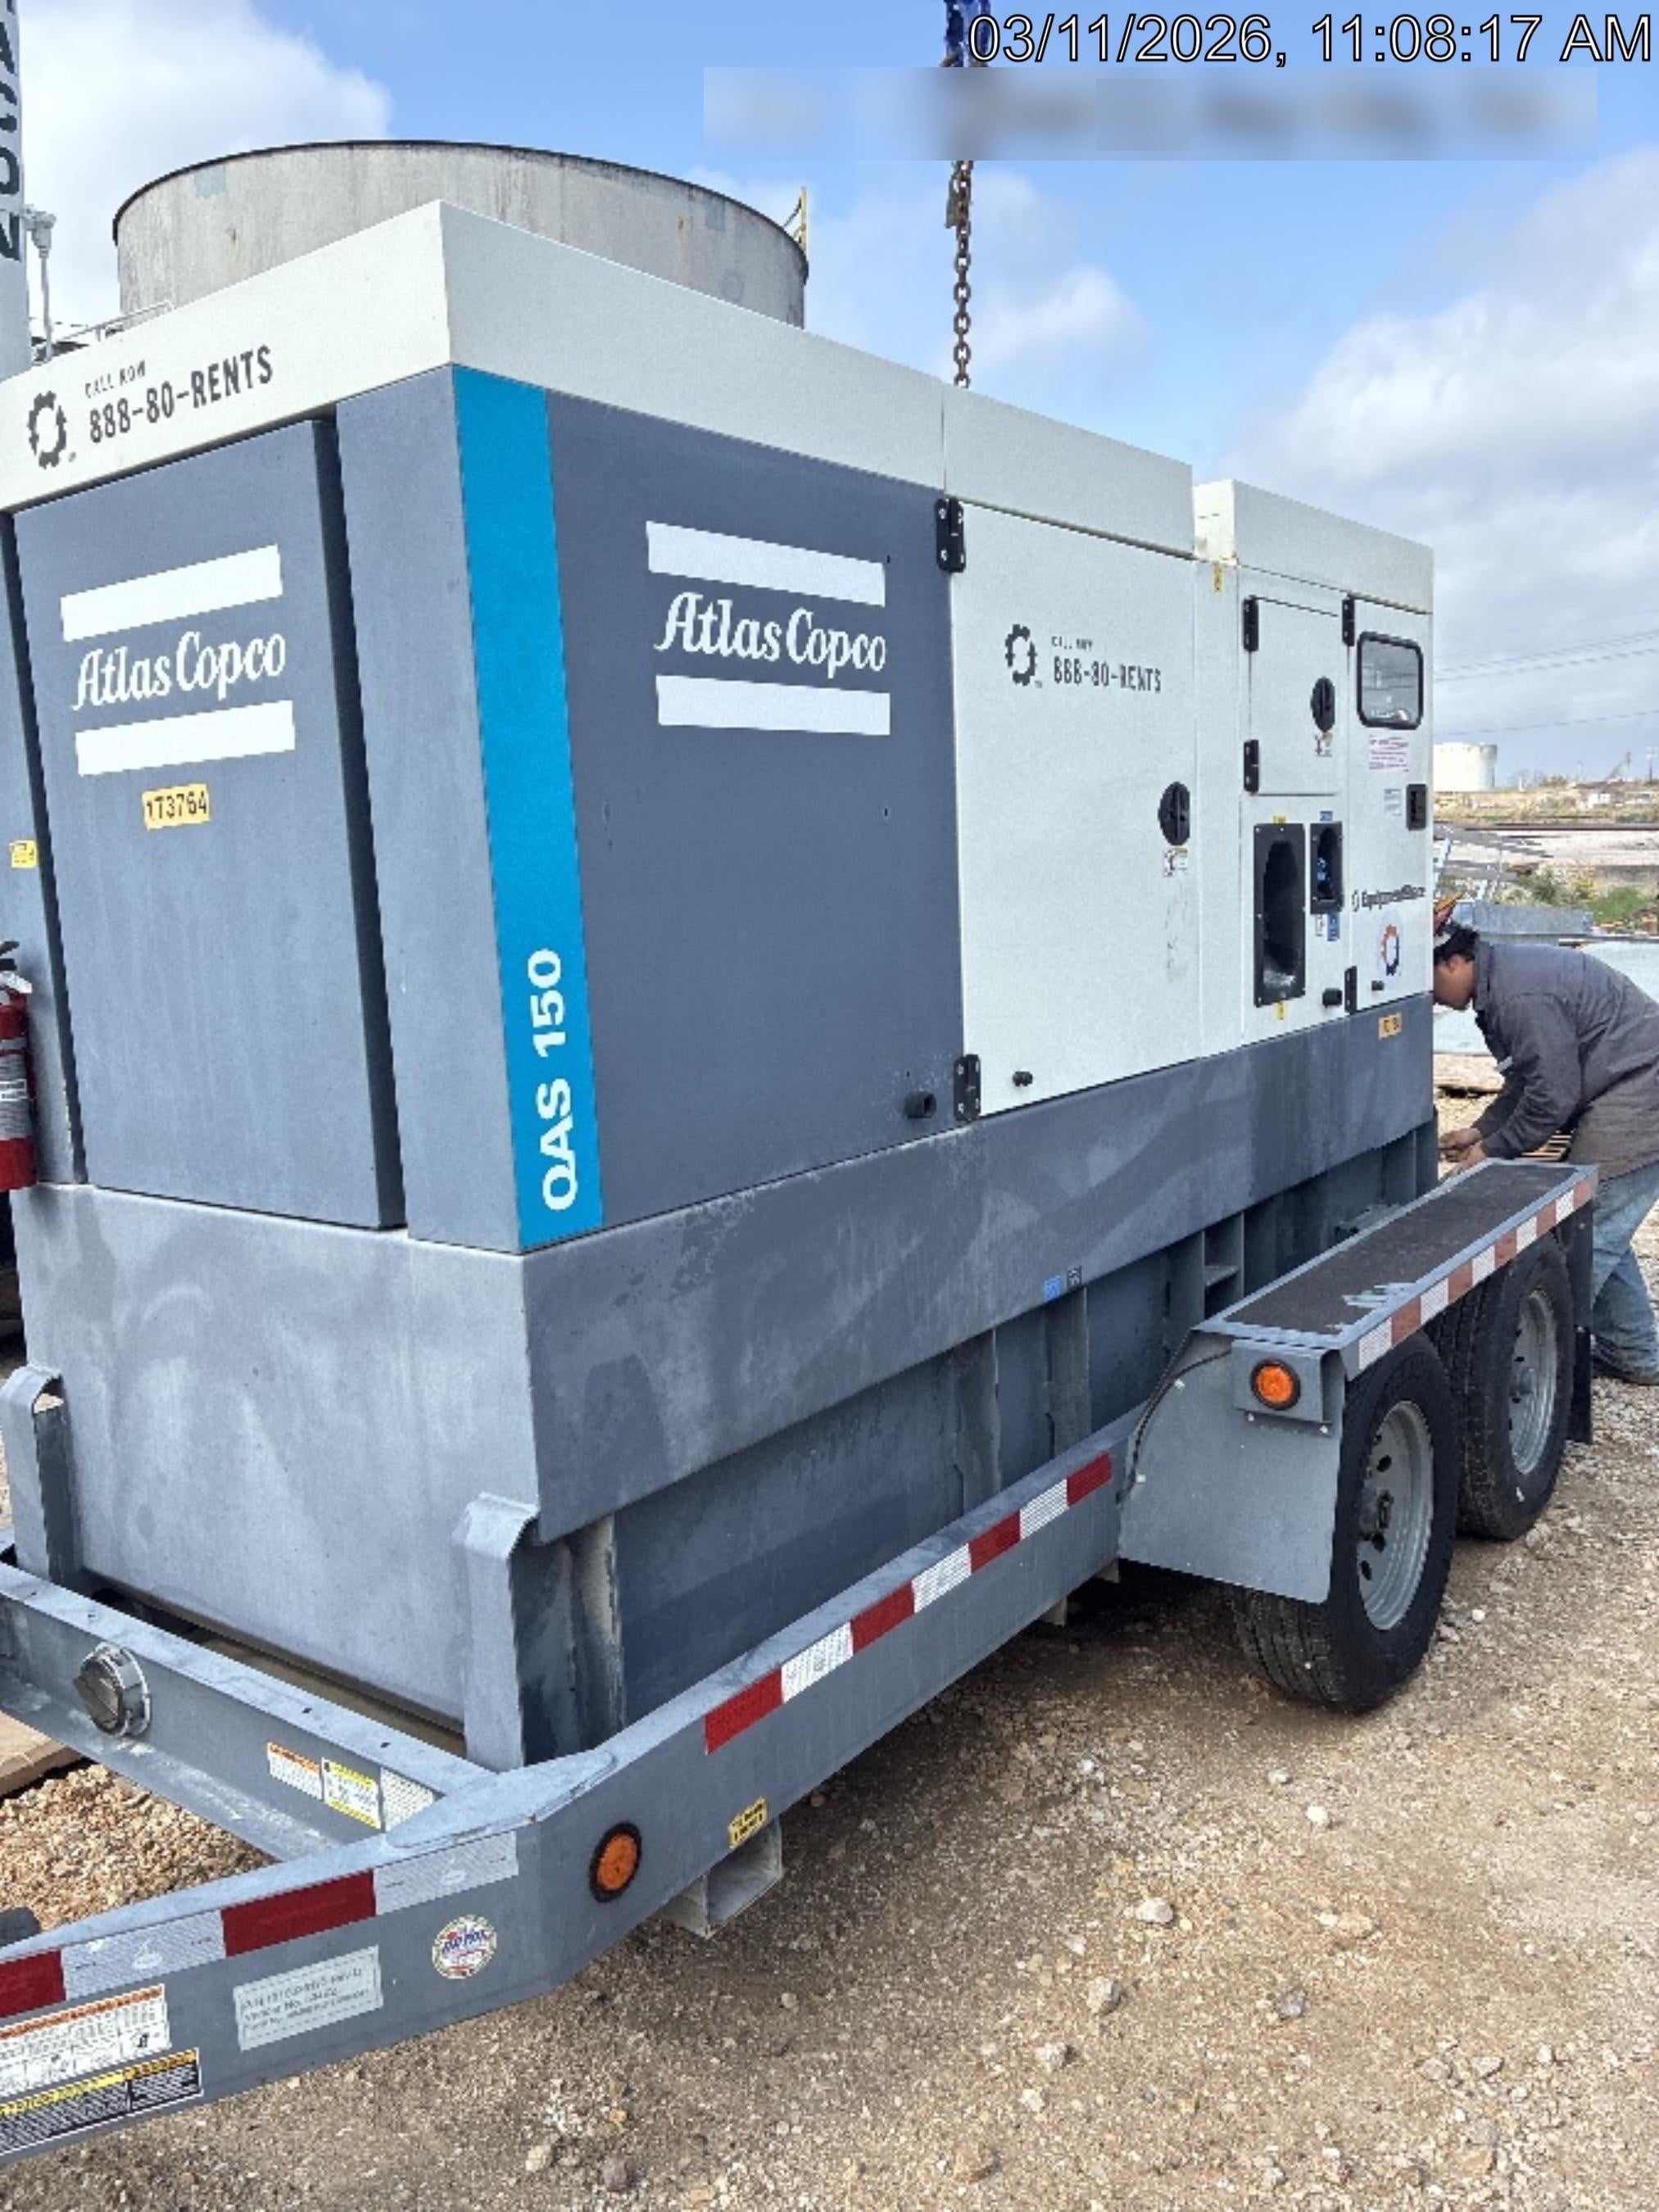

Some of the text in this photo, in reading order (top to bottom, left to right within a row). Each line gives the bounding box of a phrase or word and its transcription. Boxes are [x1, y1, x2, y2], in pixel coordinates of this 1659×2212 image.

[89, 344, 274, 443] 888-80-RENTS
[70, 631, 286, 711] Atlas Copco
[654, 592, 886, 679] Atlas Copco
[146, 790, 207, 821] 173764
[527, 948, 578, 1212] QAS 150
